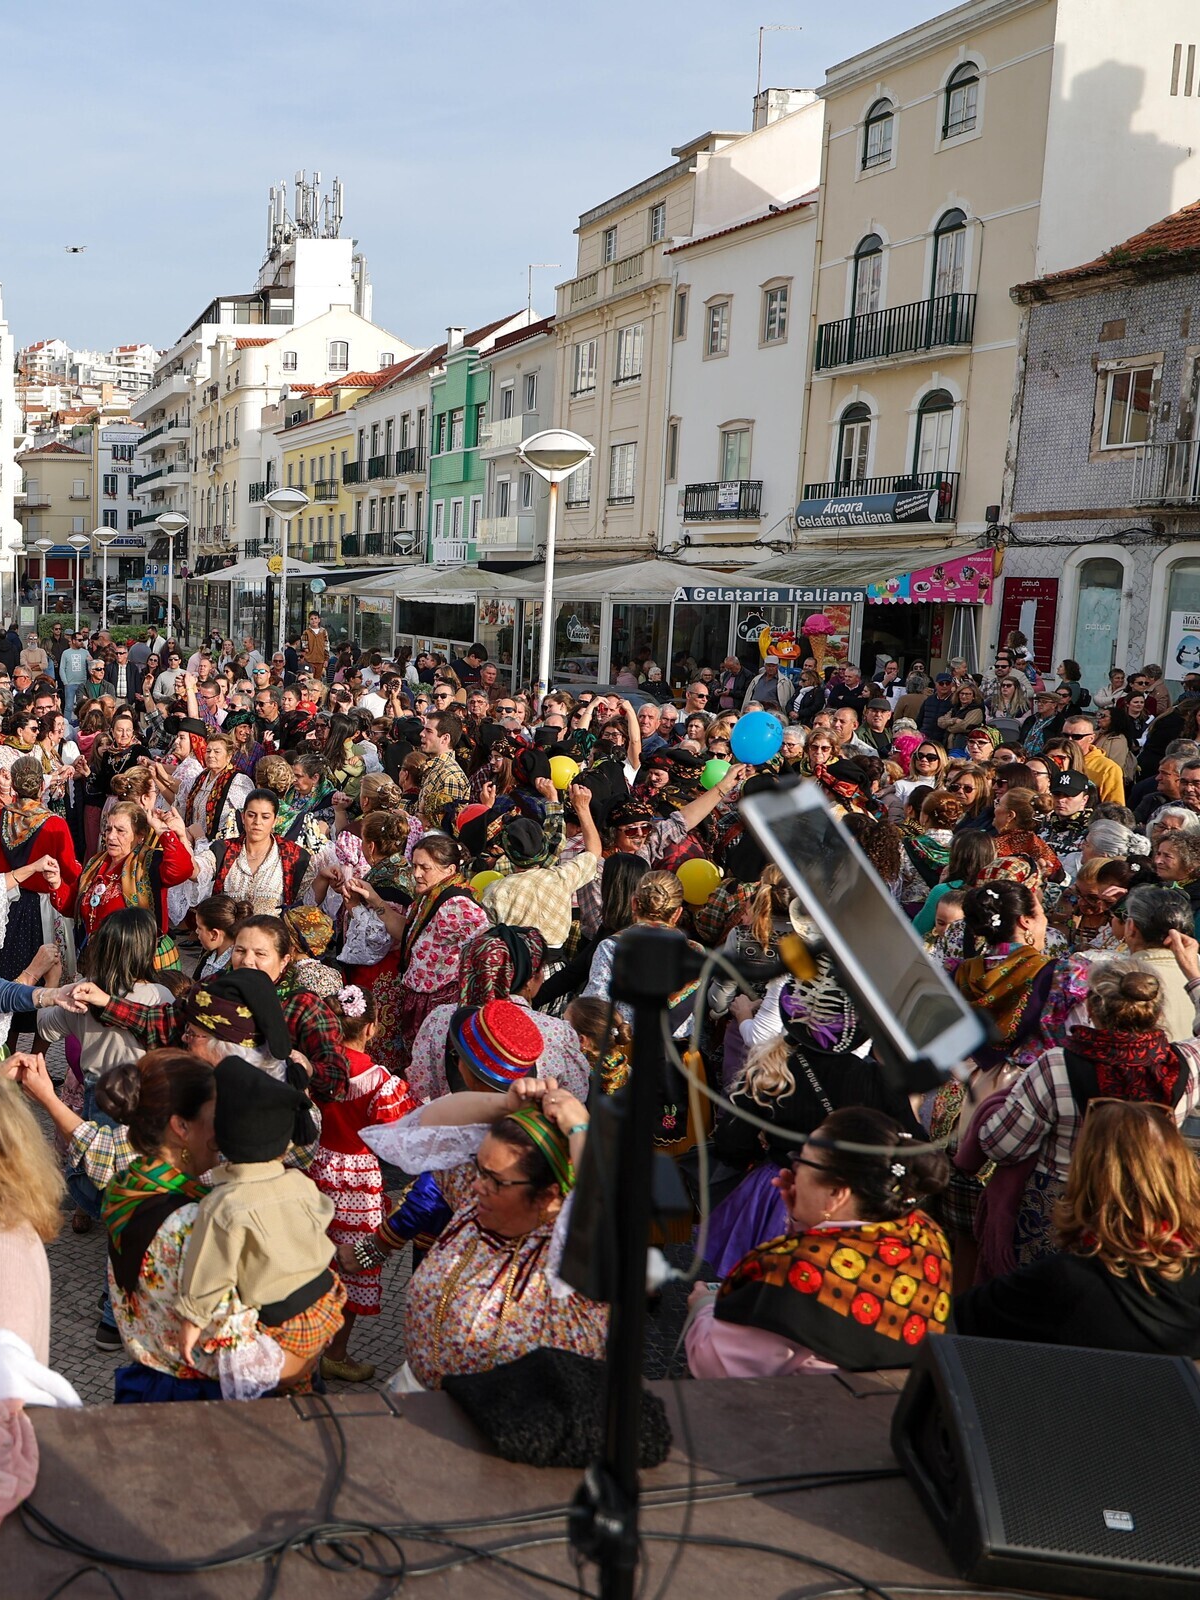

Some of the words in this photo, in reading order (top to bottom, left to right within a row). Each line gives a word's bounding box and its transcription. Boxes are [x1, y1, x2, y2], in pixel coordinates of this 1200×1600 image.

[797, 514, 847, 528] Gelataria
[849, 512, 893, 525] Italiana
[694, 587, 779, 601] Gelataria
[789, 588, 864, 602] Italiana
[805, 1068, 822, 1093] YOUNG
